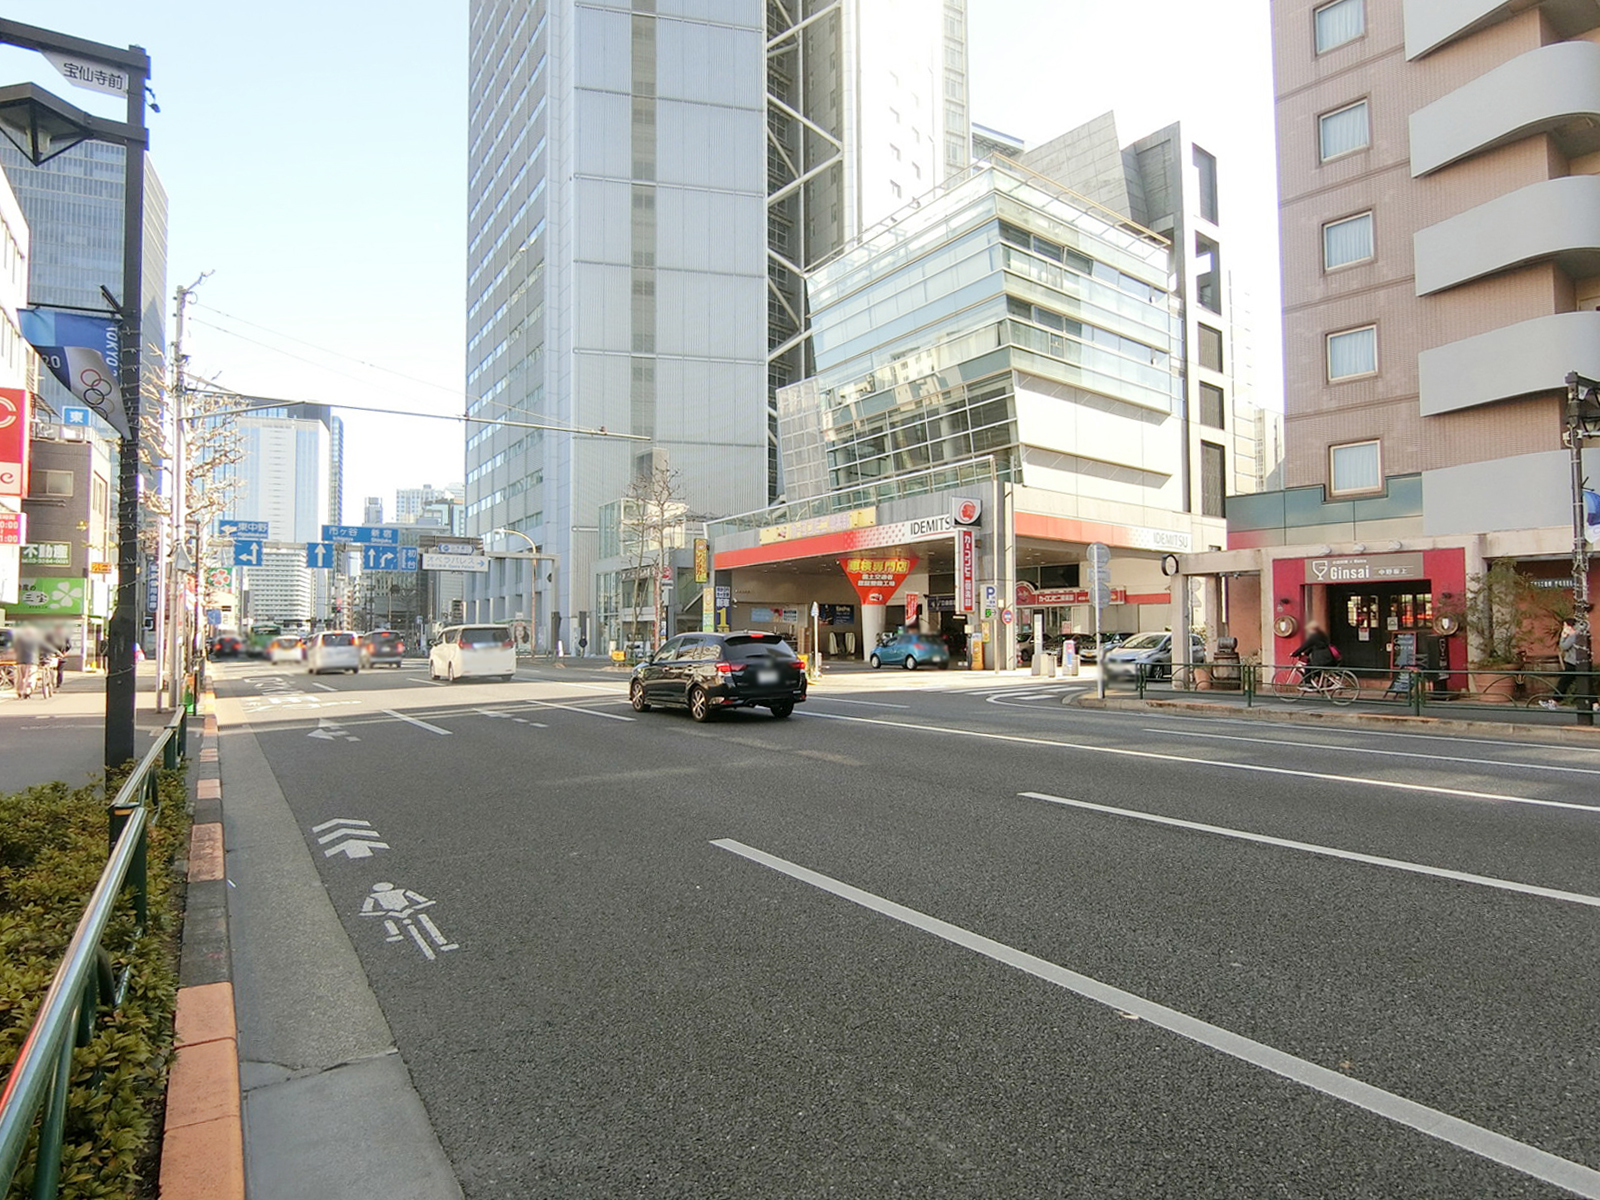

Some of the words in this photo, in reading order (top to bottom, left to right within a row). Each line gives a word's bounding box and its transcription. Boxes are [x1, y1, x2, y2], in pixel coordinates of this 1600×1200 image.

[63, 62, 123, 90] 宝仙寺前
[105, 325, 119, 367] TOKYO
[238, 522, 268, 532] 東中野
[371, 528, 393, 538] 新宿
[910, 515, 953, 536] IDEMITS
[1153, 531, 1188, 548] IDEMITSU
[407, 549, 416, 569] 初台
[1330, 565, 1369, 579] Ginsai
[986, 586, 995, 599] P
